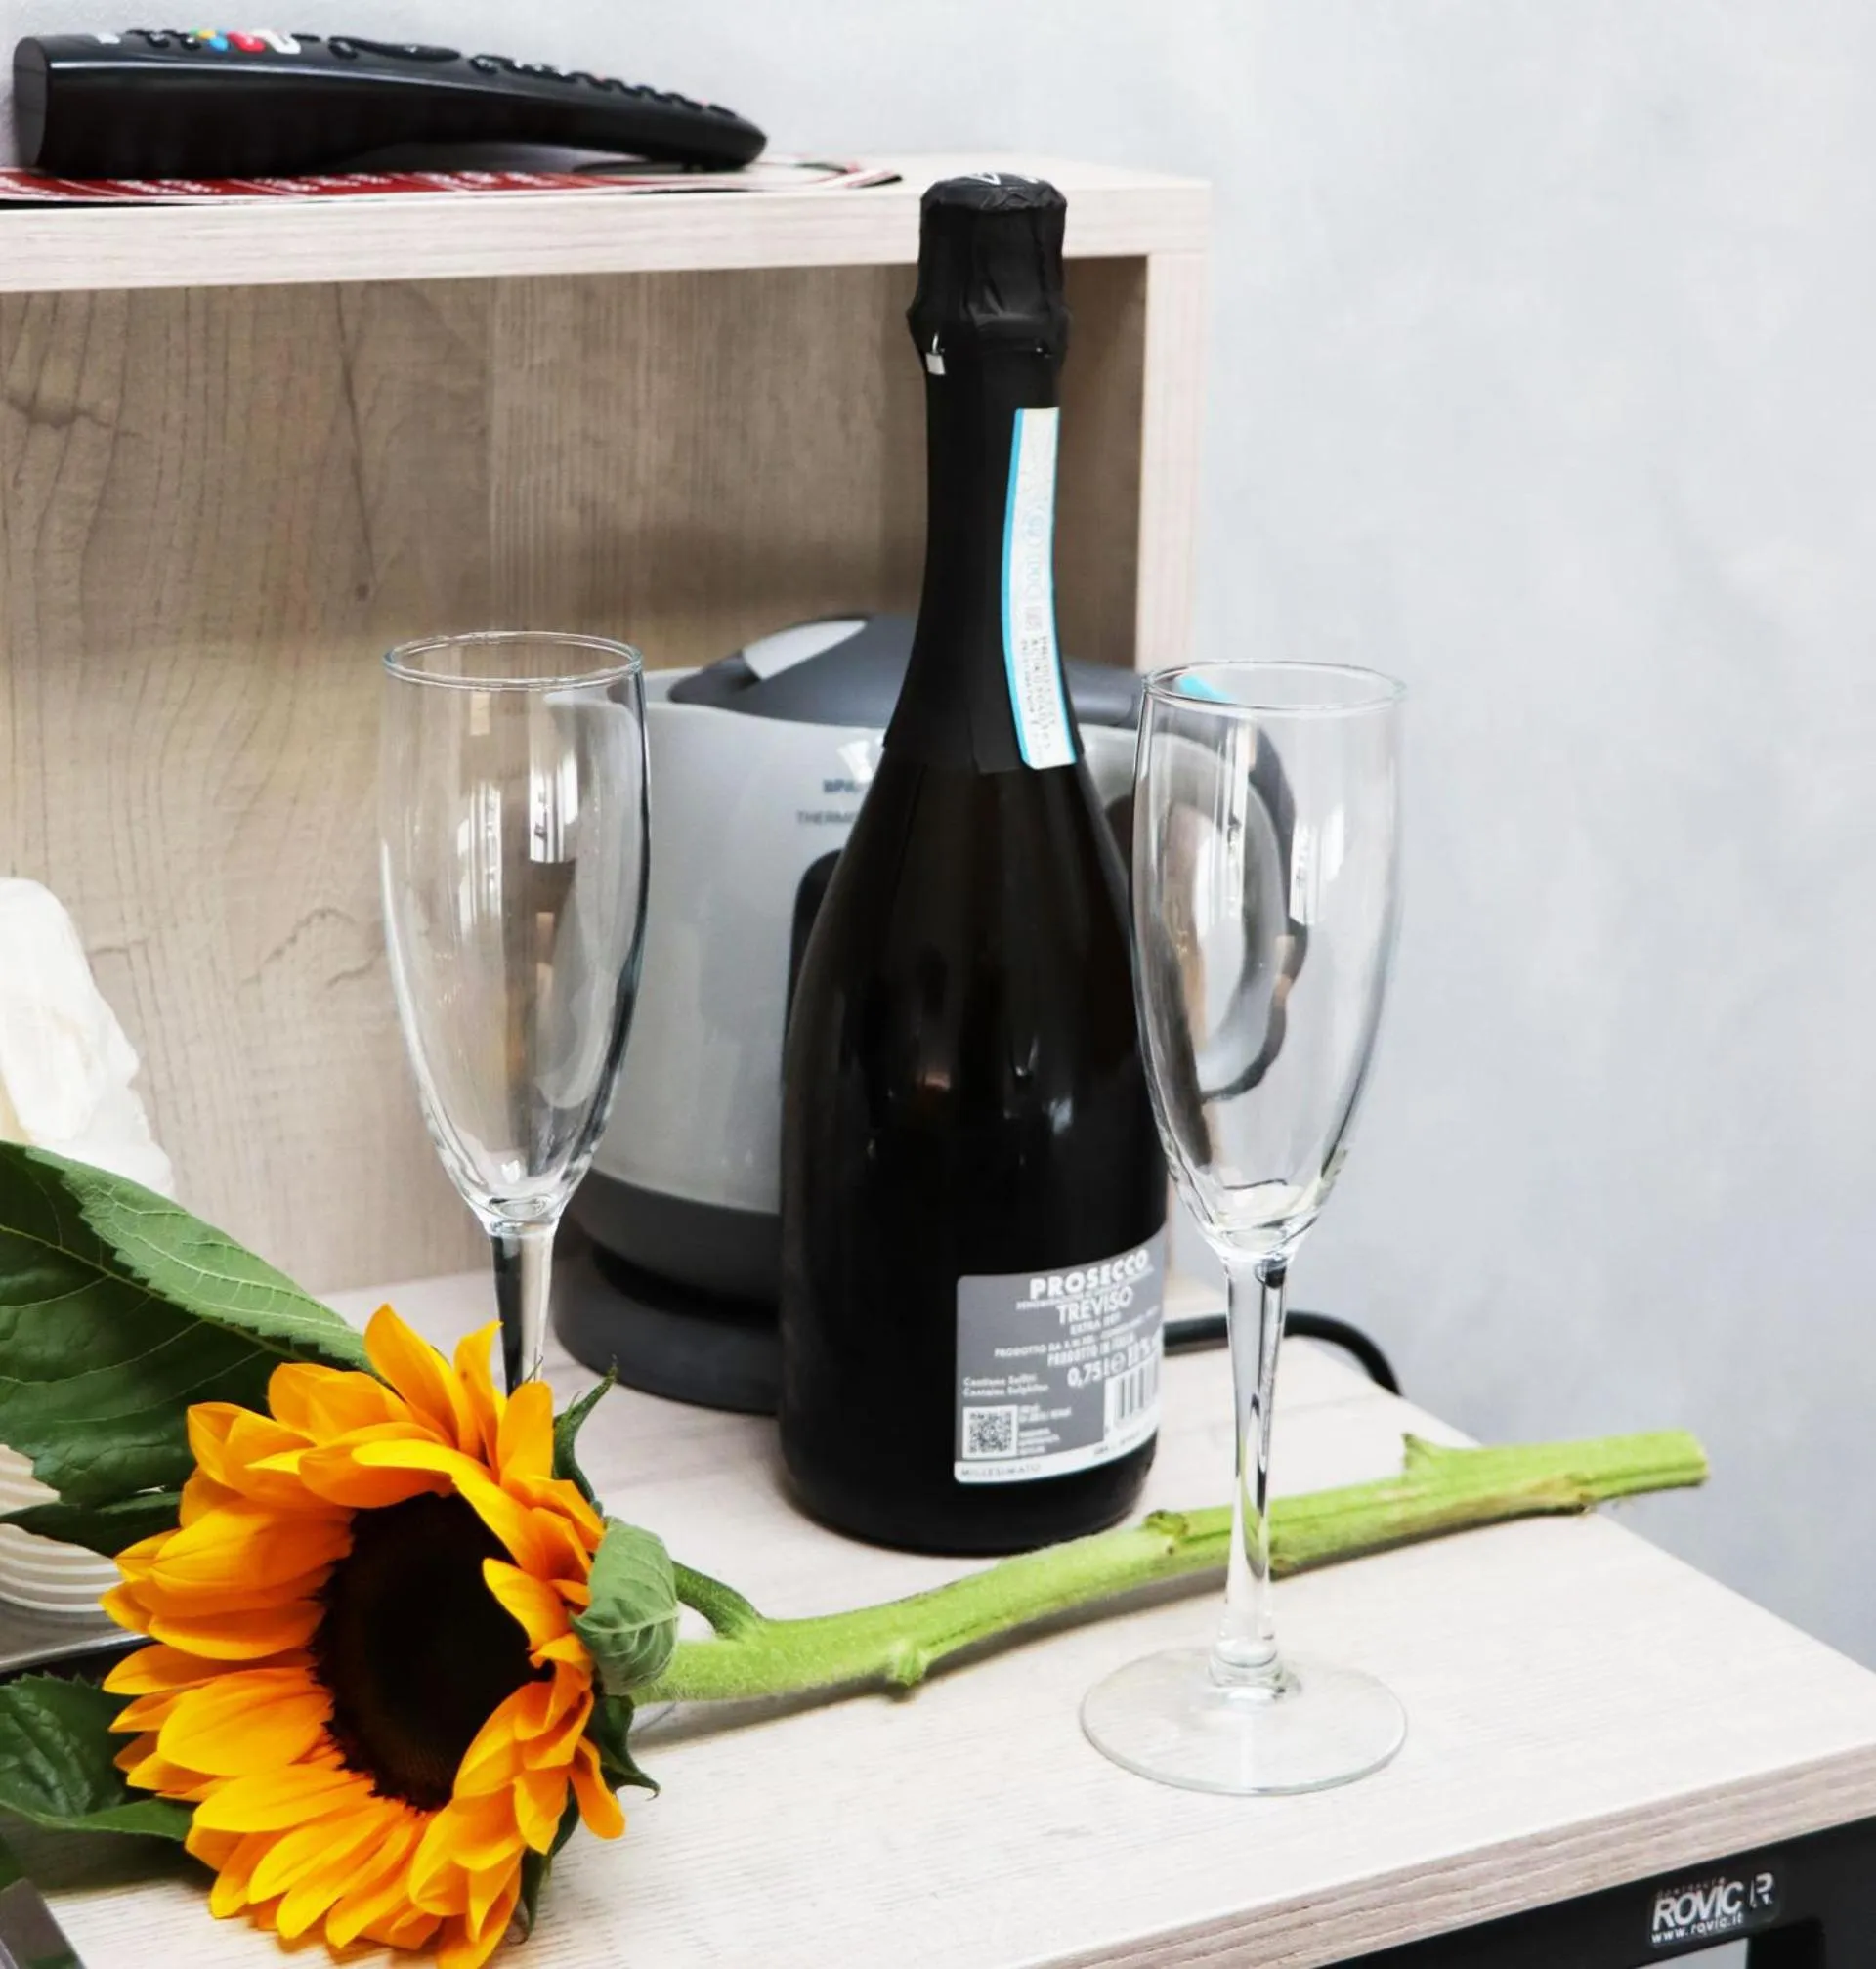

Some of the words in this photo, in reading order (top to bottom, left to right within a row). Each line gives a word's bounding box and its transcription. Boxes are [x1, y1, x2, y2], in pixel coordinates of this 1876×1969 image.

[1029, 1249, 1149, 1300] PROSECCO
[1056, 1286, 1133, 1326] TREVISO
[994, 1344, 1046, 1357] PRODOTTO
[1047, 1345, 1098, 1367] PRODOTTO
[1652, 1881, 1745, 1932] ROVIC
[1651, 1911, 1744, 1944] www.rovic.it
